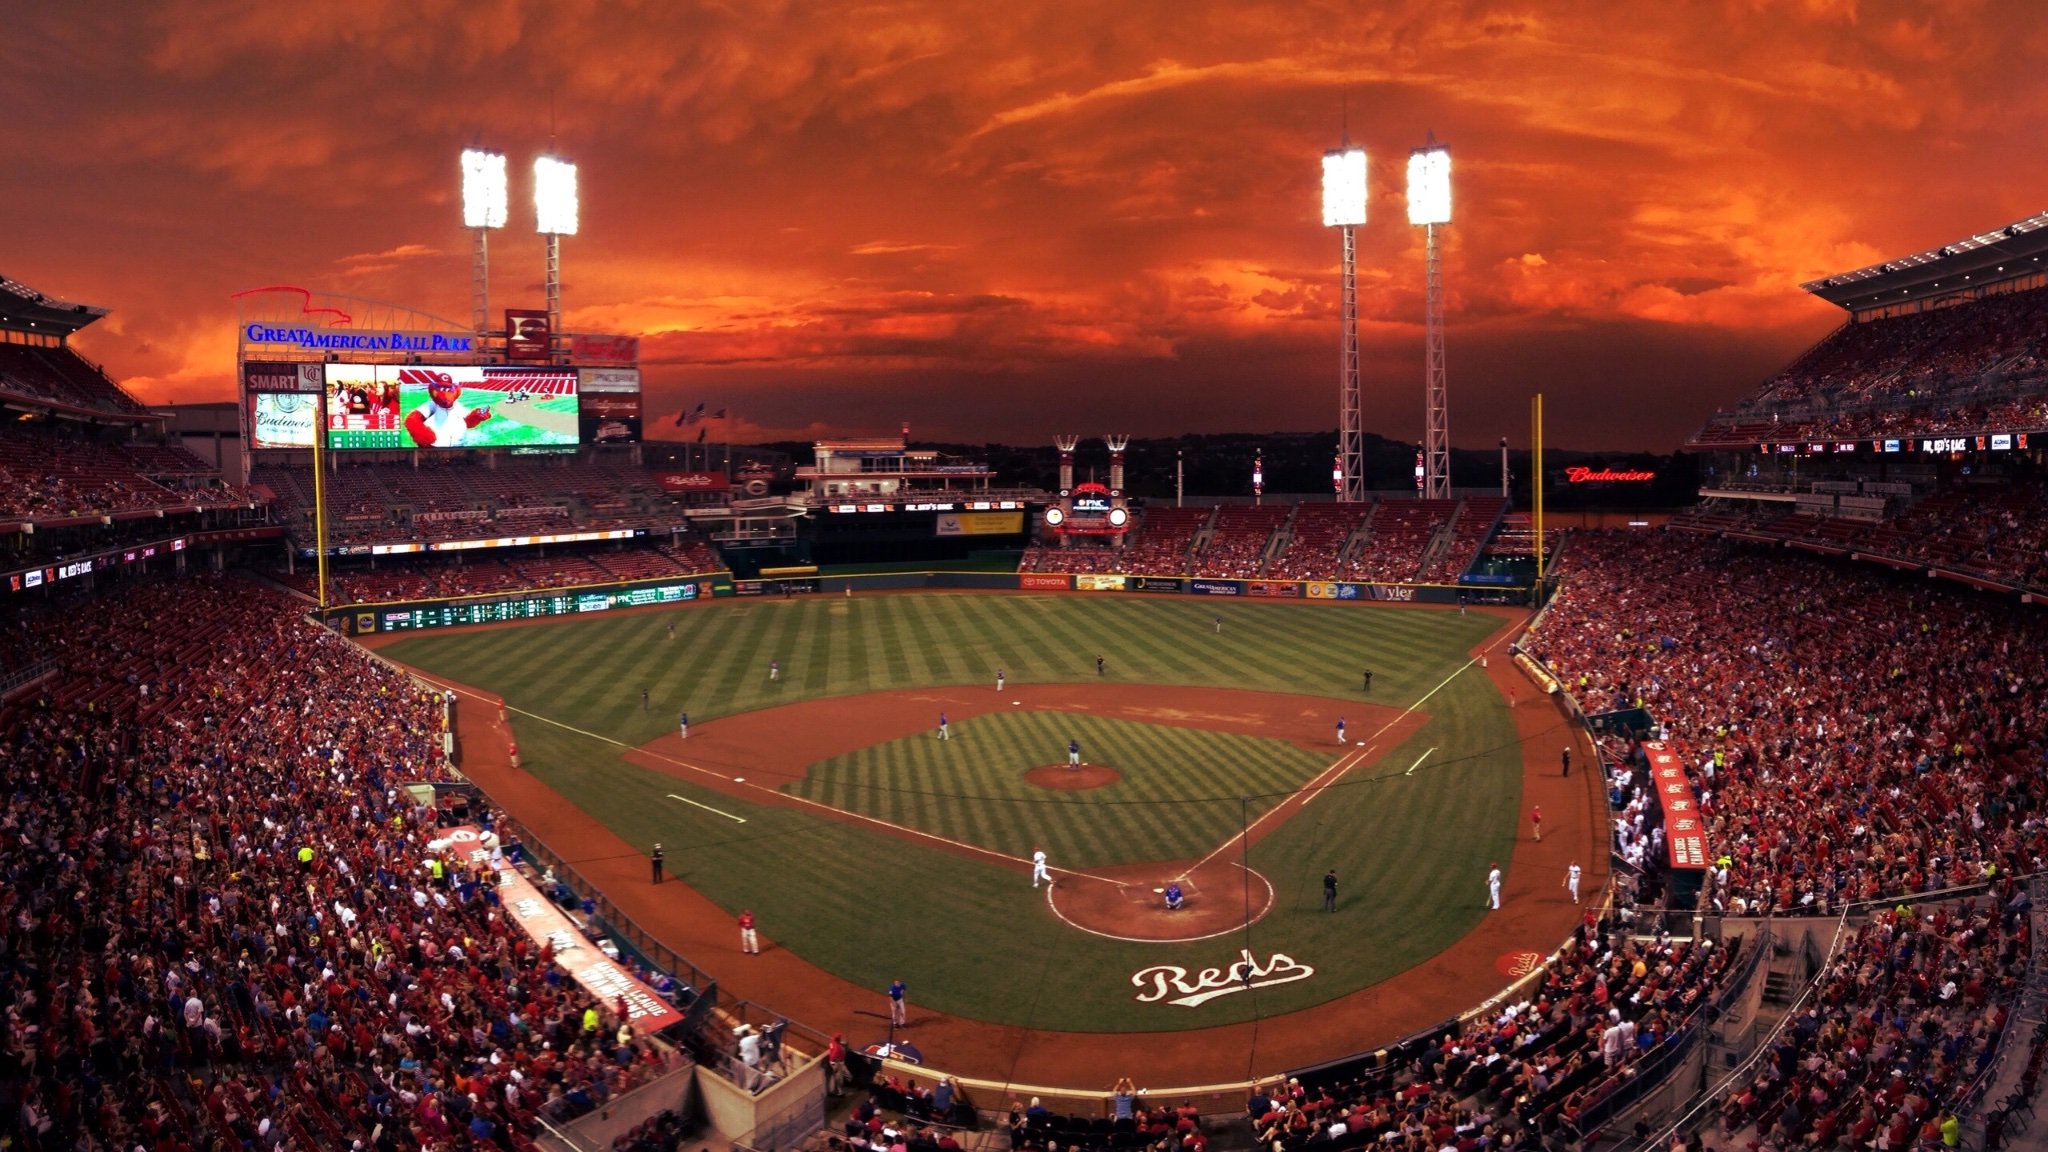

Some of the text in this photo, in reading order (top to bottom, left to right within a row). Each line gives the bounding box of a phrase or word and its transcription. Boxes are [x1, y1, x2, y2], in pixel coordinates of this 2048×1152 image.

[391, 333, 430, 350] BALL
[431, 334, 471, 351] PARK
[249, 375, 296, 389] SMART
[1565, 466, 1654, 482] Budweiser
[1086, 499, 1104, 507] PNC
[1131, 949, 1315, 1008] Reds
[629, 989, 668, 1017] LEAGUE
